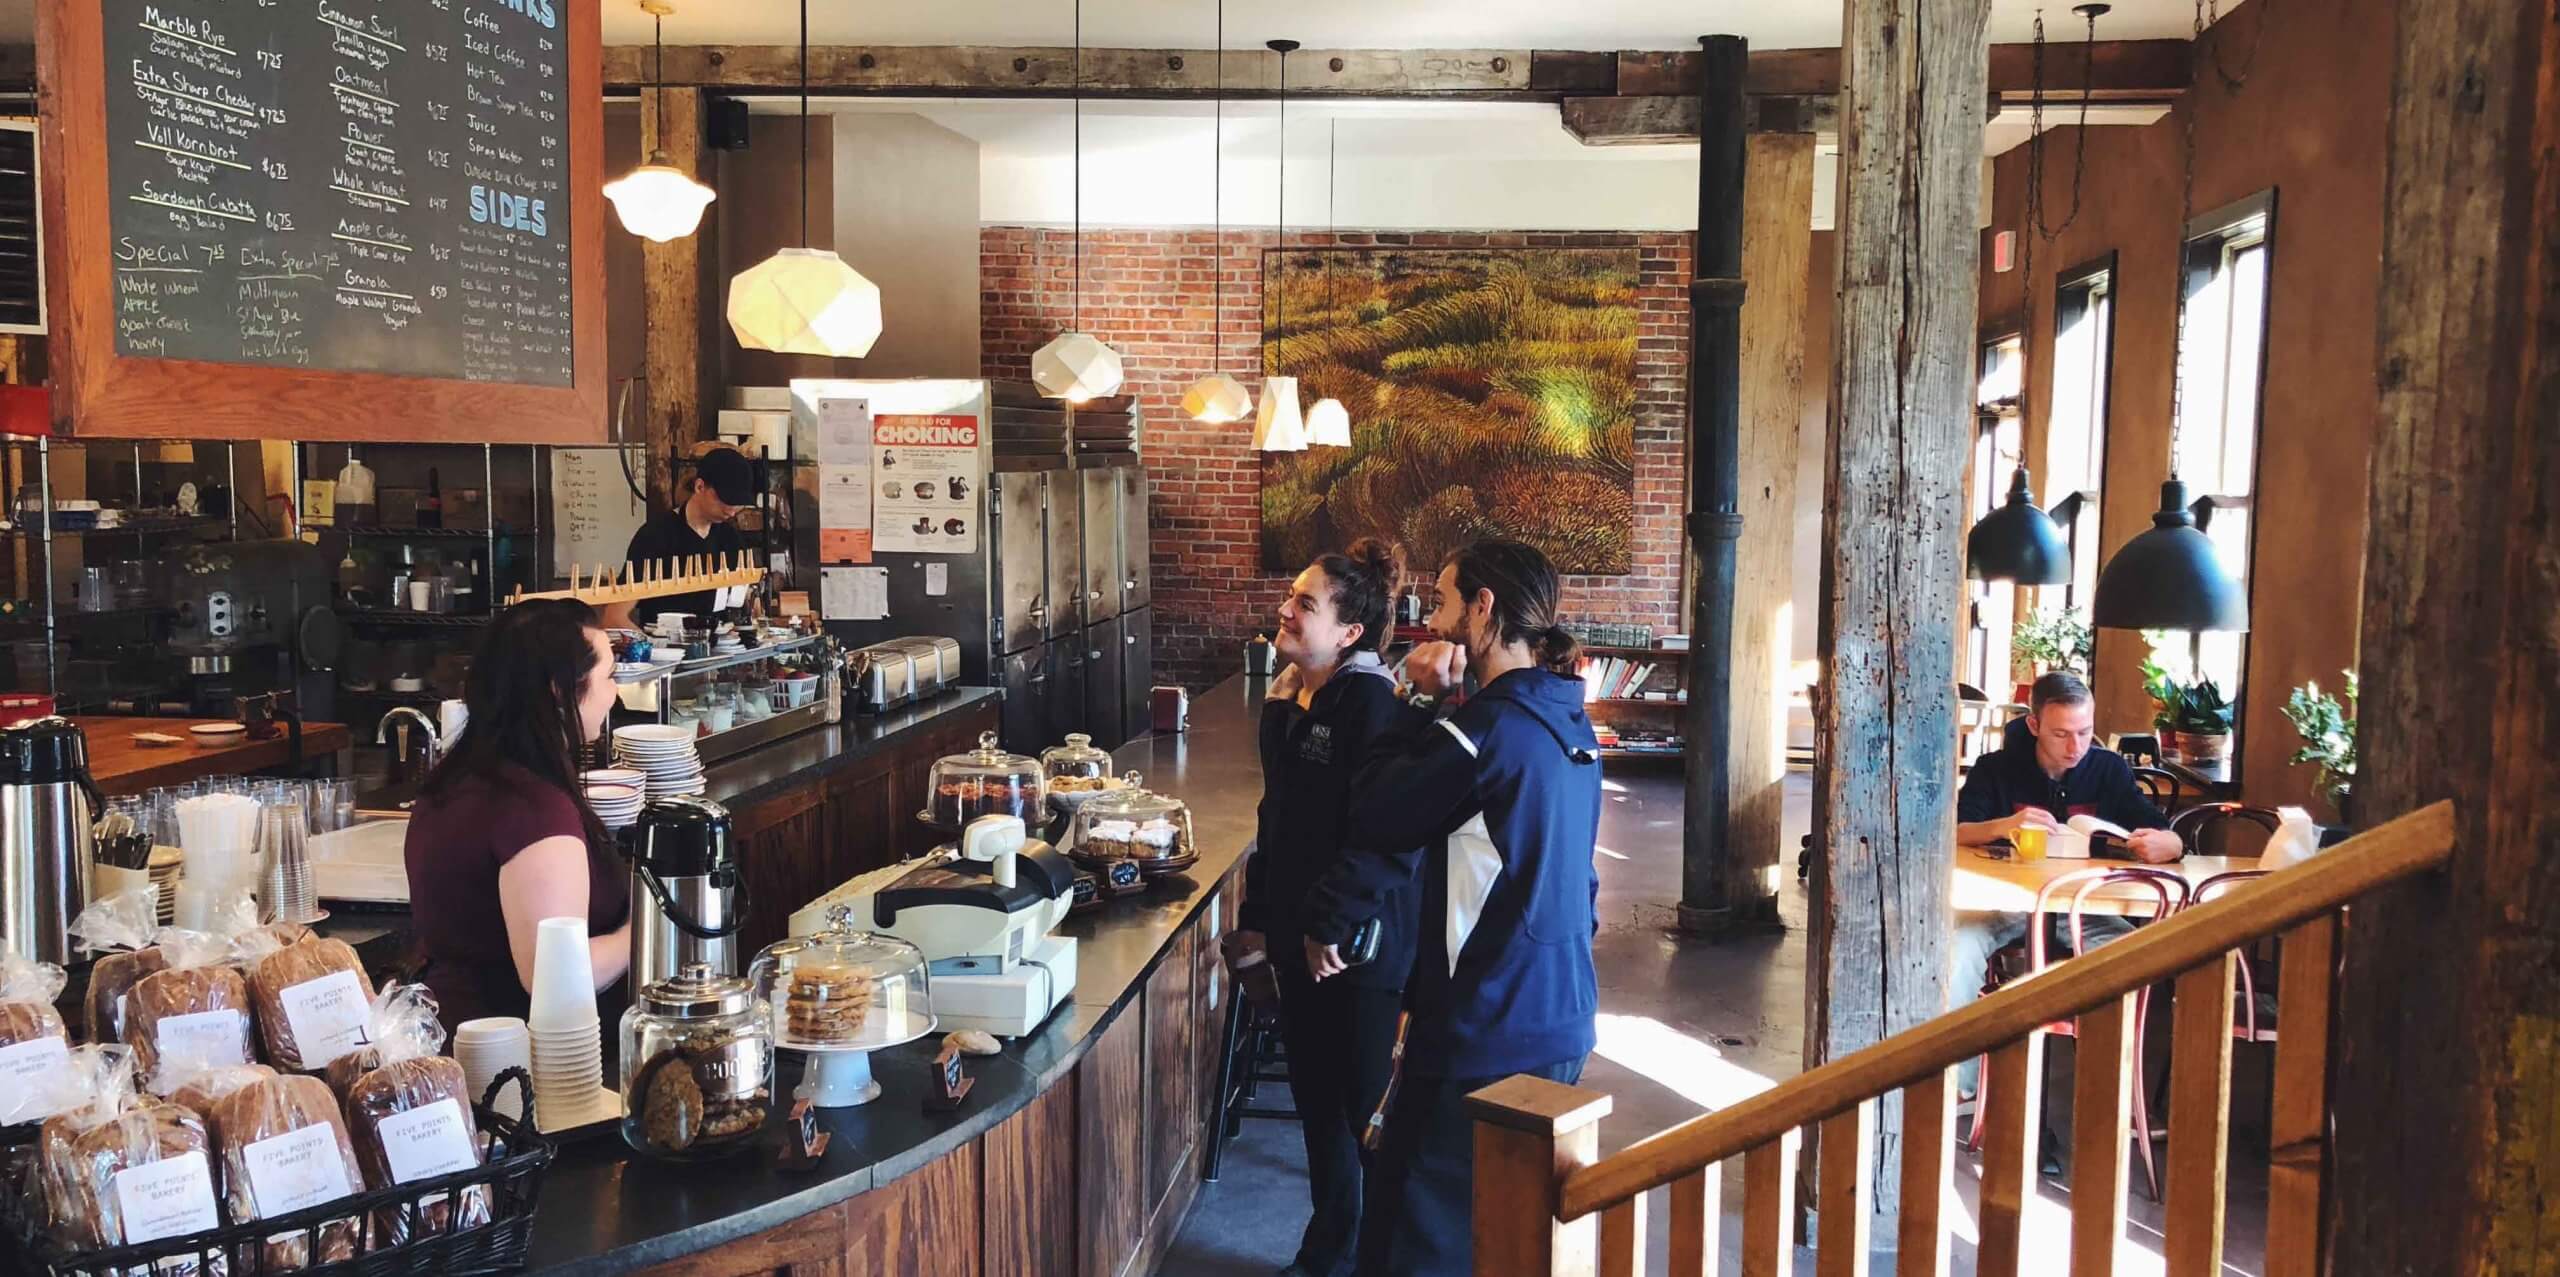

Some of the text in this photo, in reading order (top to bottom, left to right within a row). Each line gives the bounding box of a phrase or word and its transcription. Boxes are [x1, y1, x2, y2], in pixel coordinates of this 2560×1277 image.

[145, 6, 225, 47] Marble Rye
[464, 7, 501, 34] Coffee
[464, 33, 527, 70] Iced Coffee
[133, 59, 257, 112] Extra Sharp Cheddar
[335, 65, 388, 97] Oatmeal
[466, 61, 505, 86] Hot Tea
[146, 122, 172, 142] Voll
[348, 122, 384, 145] Power
[467, 113, 497, 136] Juice
[333, 167, 406, 198] Whole Wheat
[142, 181, 205, 214] Sourdough
[169, 211, 190, 231] egg
[469, 184, 547, 238] SIDES
[338, 218, 408, 243] Apple Cider
[115, 237, 190, 268] Special
[120, 277, 158, 296] Whole
[345, 269, 391, 289] Granola
[875, 426, 977, 445] CHOKING
